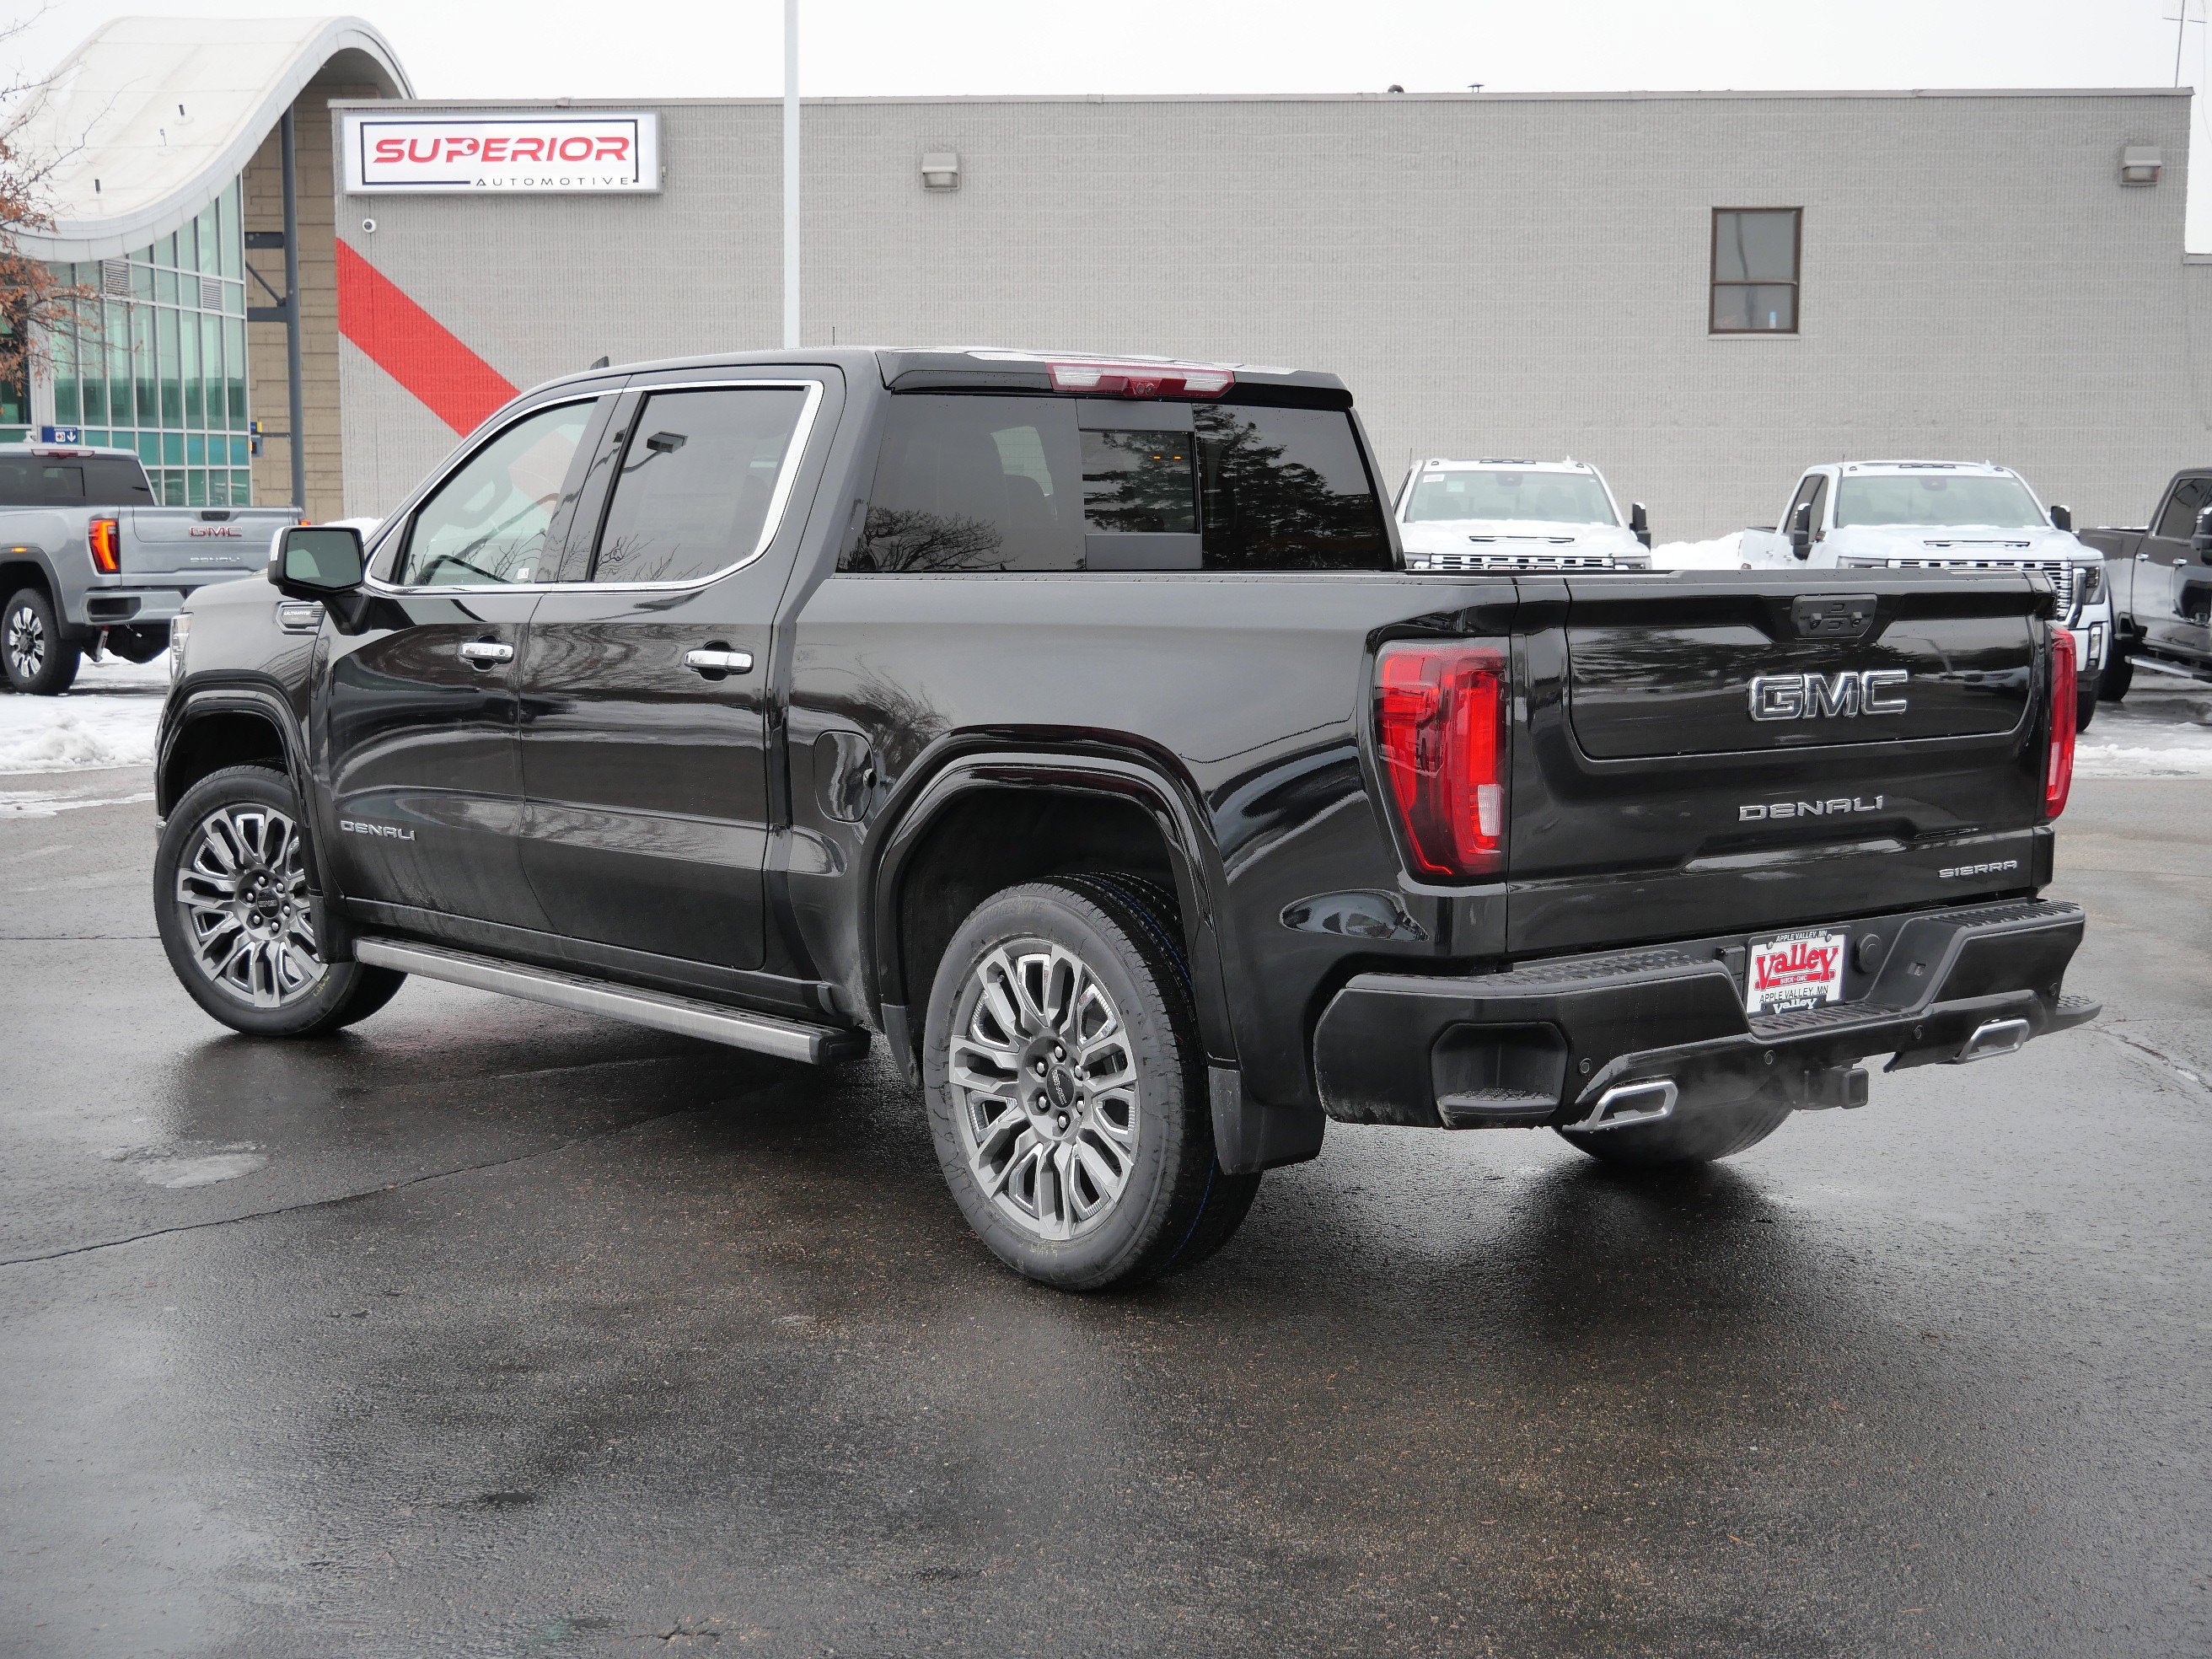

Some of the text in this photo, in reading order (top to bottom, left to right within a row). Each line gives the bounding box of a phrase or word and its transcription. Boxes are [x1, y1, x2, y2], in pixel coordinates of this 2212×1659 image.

[373, 137, 630, 164] SUPERIOR
[475, 177, 629, 186] AUTOMOTIVE
[189, 526, 243, 537] GMC
[1748, 669, 1908, 722] GMC
[1738, 796, 1883, 821] DENALI
[341, 820, 416, 841] DENALI
[1938, 860, 2018, 878] SIERRA
[1775, 934, 1795, 942] APPLE
[1759, 991, 1783, 1003] APPLE
[1817, 985, 1828, 995] MN
